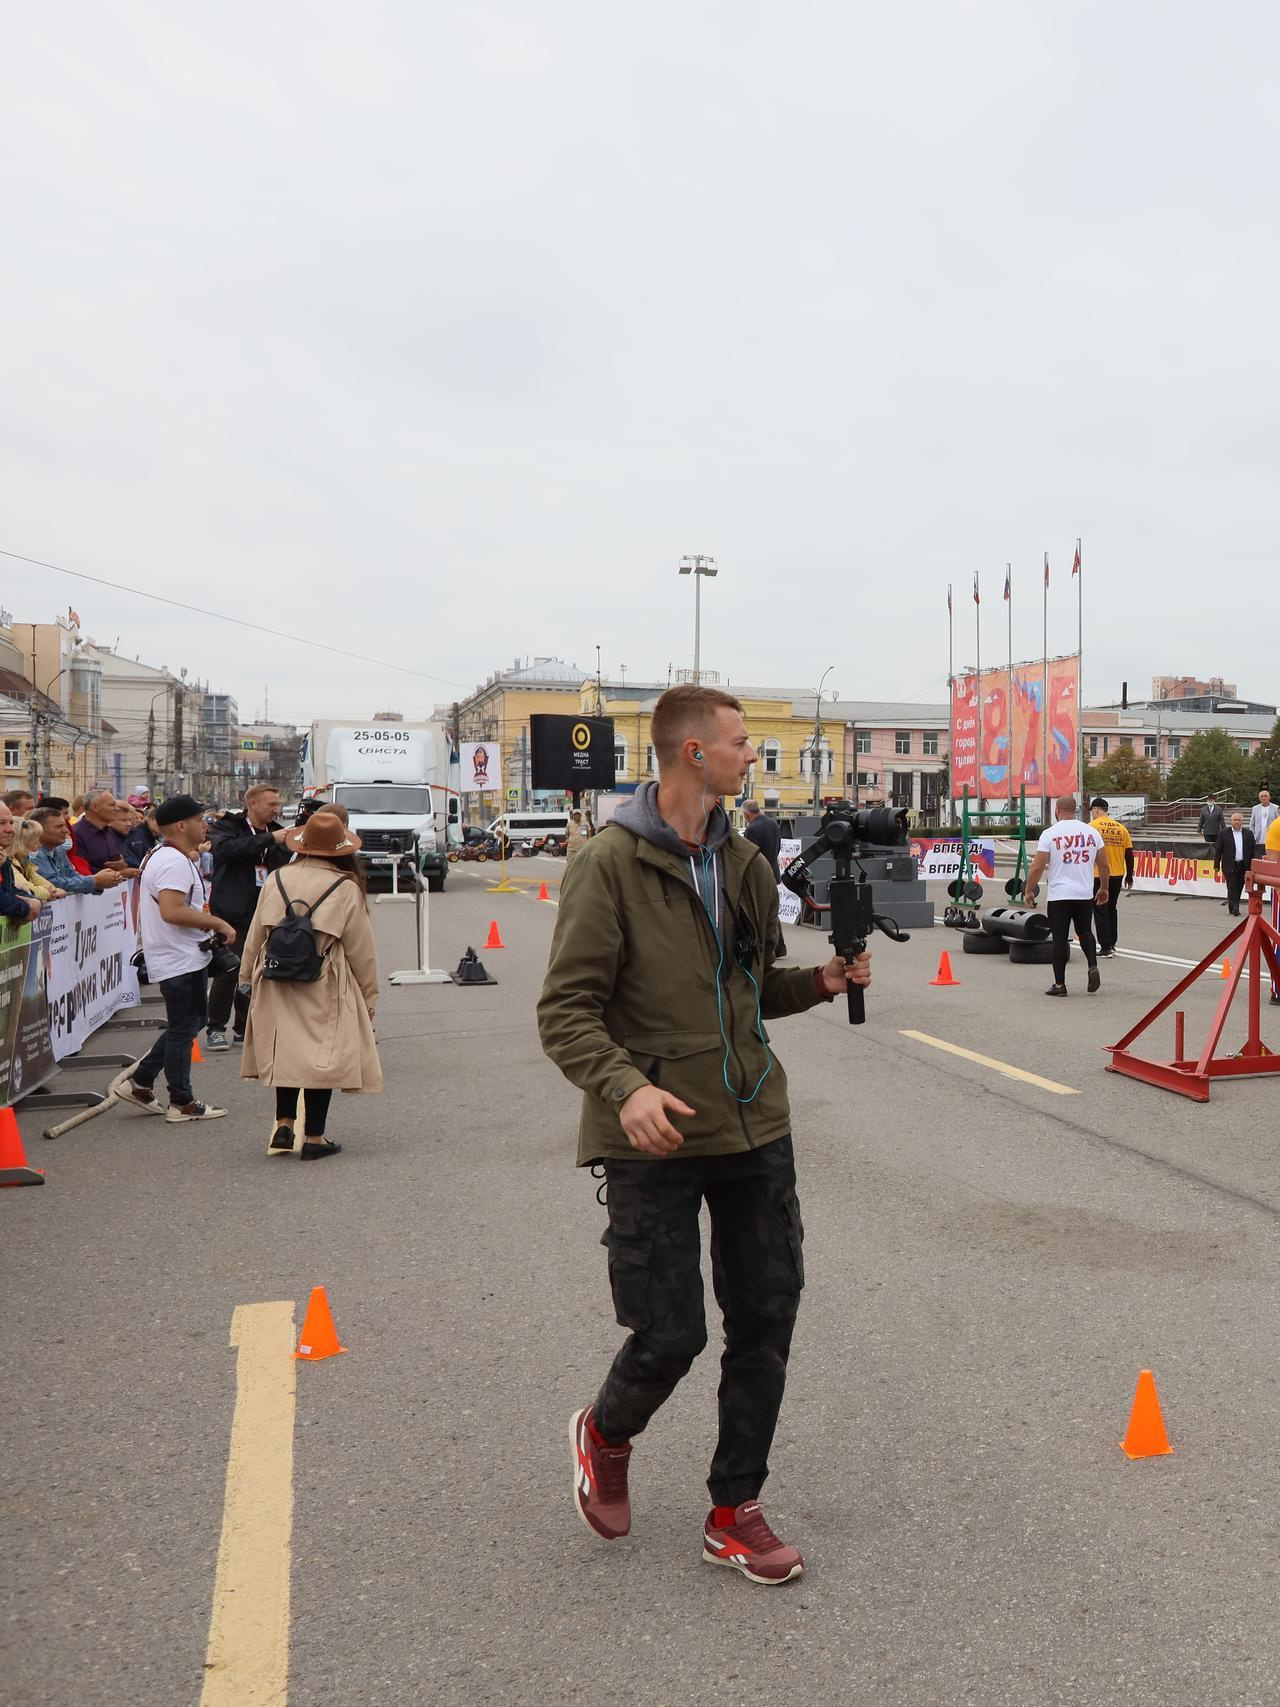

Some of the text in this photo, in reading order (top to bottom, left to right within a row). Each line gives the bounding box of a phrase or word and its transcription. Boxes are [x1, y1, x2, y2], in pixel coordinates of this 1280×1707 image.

[354, 731, 410, 741] 25-05-05
[933, 843, 983, 855] ВПЕРД!
[1053, 832, 1096, 851] ТУЛА
[787, 857, 806, 877] RONIN
[1063, 850, 1090, 865] 875
[1132, 850, 1161, 879] ИЛА
[1164, 851, 1198, 886] Тулы
[74, 920, 97, 970] Тула
